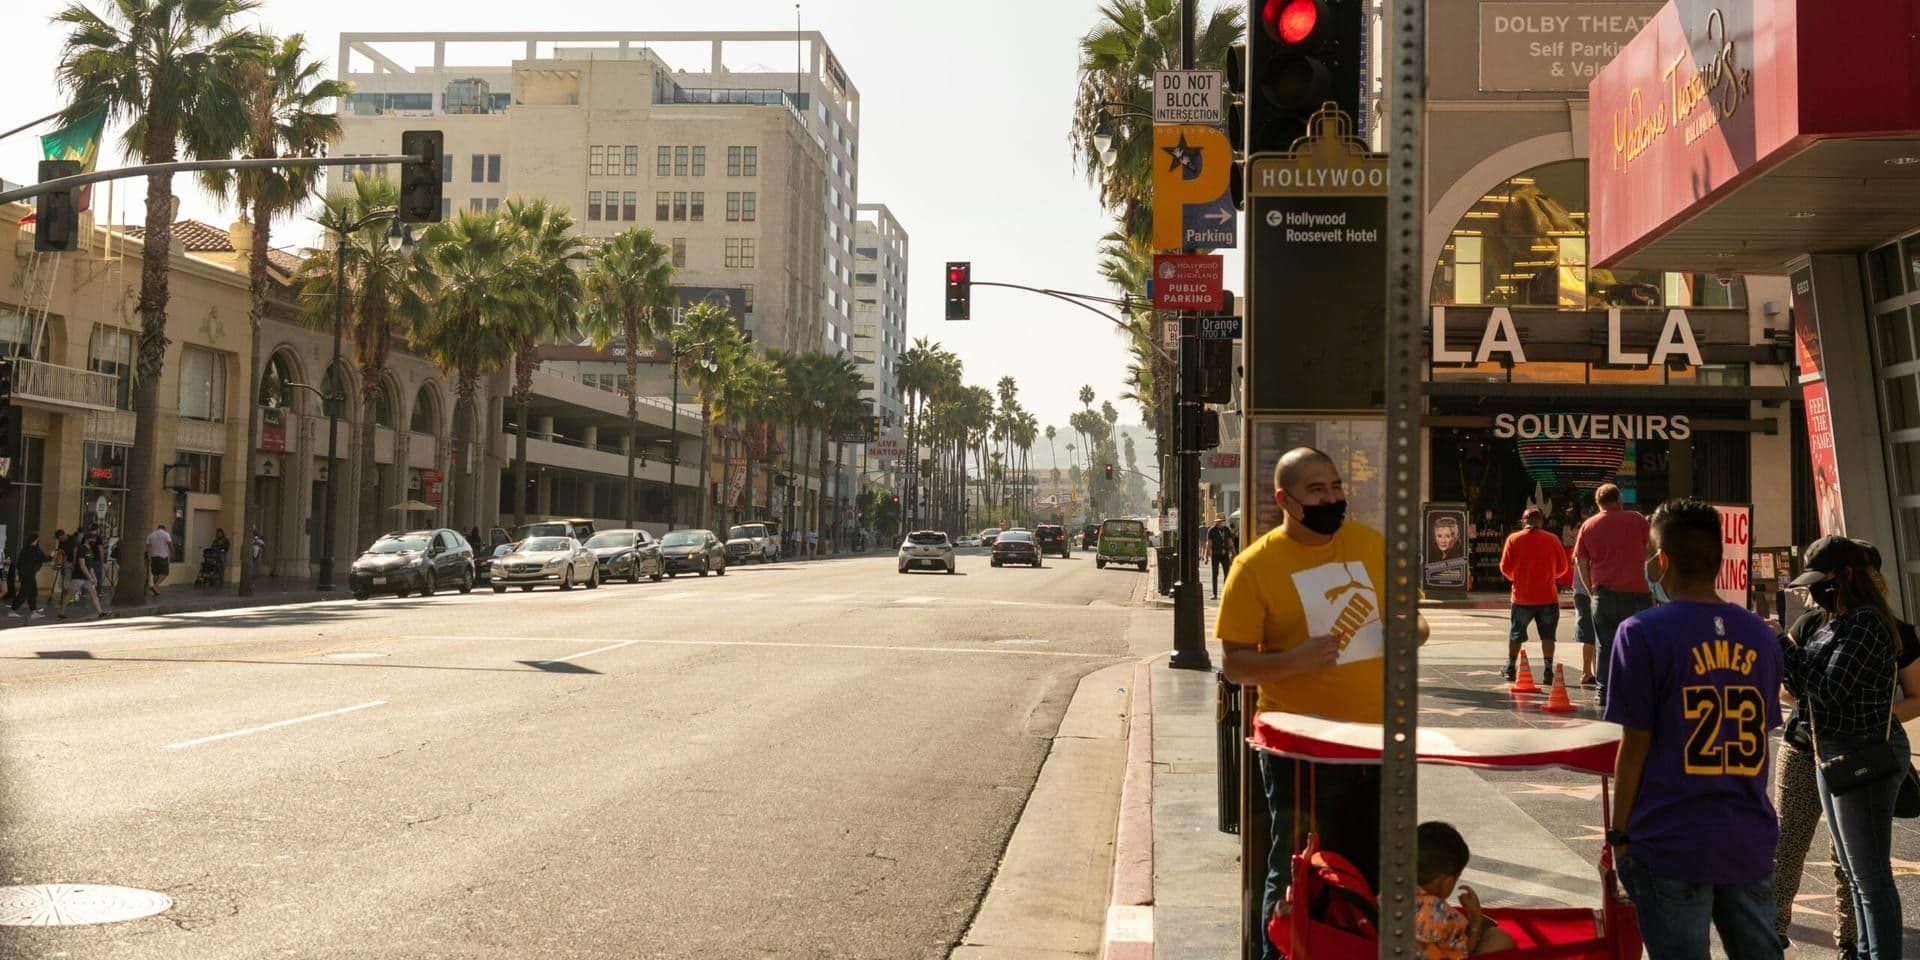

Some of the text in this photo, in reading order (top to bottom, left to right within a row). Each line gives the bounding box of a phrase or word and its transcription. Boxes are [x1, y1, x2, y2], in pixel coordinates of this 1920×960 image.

[1494, 16, 1570, 33] DOLBY
[1529, 42, 1564, 57] Self
[1551, 62, 1564, 77] &
[1163, 75, 1213, 90] DO NOT
[1614, 8, 1738, 175] Madame Tussauds
[1167, 92, 1209, 107] BLOCK
[1157, 109, 1219, 119] INTERSECTION
[1262, 168, 1391, 187] HOLLYWOO
[1286, 212, 1346, 227] Hollywood
[1186, 229, 1233, 245] Parking
[1286, 229, 1377, 242] Roosevelt Hotel
[1168, 284, 1207, 292] PUBLIC
[1163, 294, 1212, 303] PARKING
[1202, 318, 1239, 333] Orange
[1202, 330, 1218, 338] 1700
[1432, 306, 1703, 366] LA LA
[1809, 396, 1827, 415] FEEL
[1494, 413, 1691, 440] SOUVENIRS
[1812, 414, 1828, 432] THE
[869, 448, 907, 456] NATION
[1692, 640, 1758, 676] JAMES
[1683, 685, 1766, 777] 23
